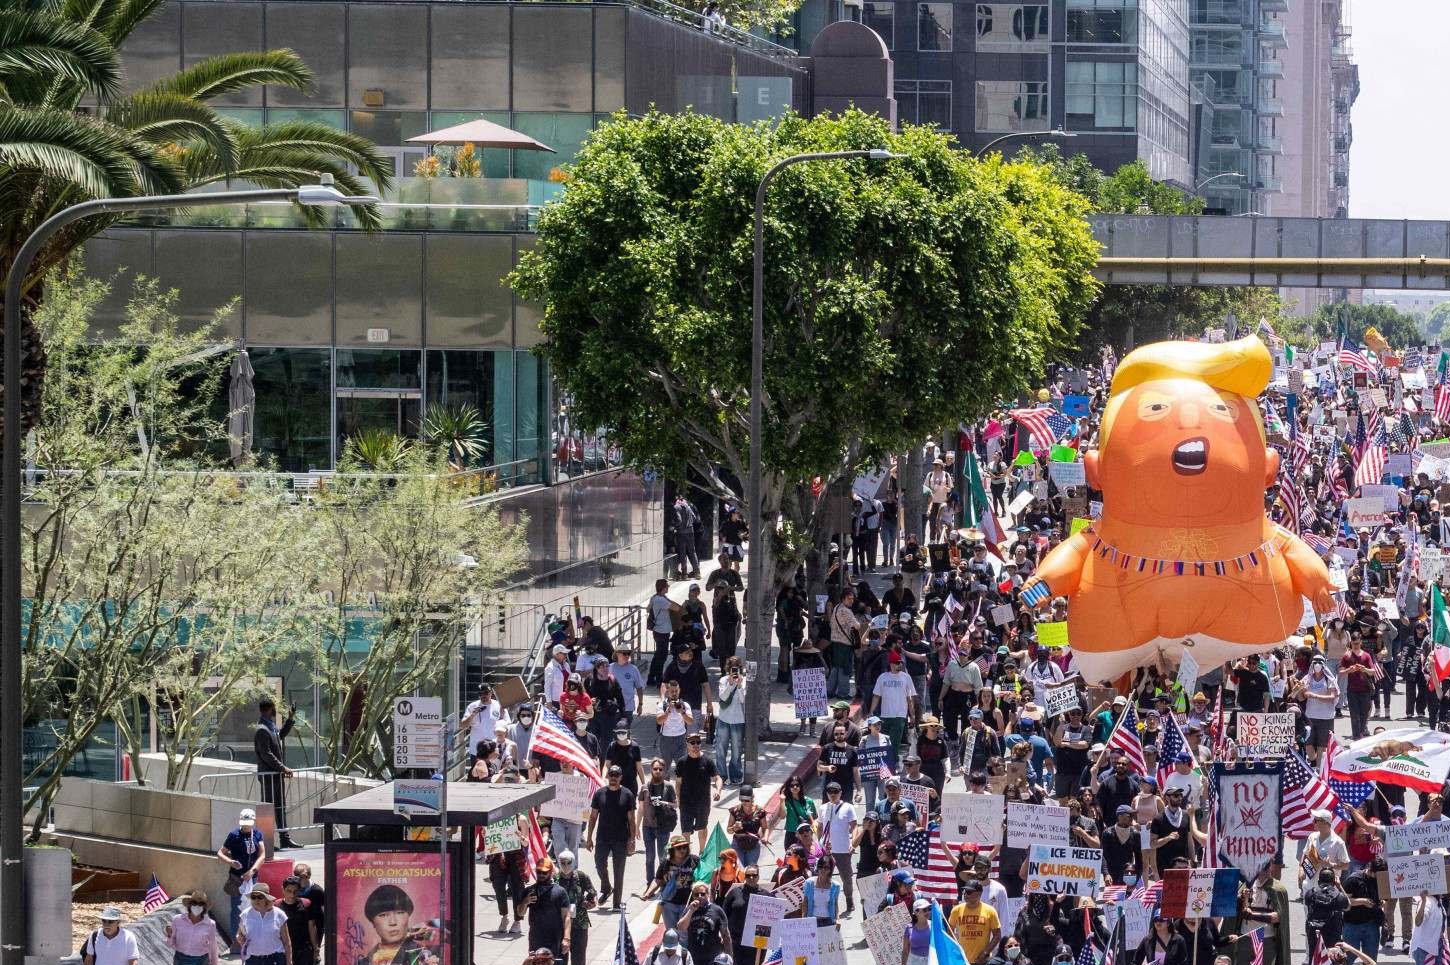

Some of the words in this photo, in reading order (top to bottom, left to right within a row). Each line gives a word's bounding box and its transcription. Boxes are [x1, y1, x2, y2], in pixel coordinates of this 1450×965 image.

[1241, 715, 1257, 727] NO
[1264, 714, 1291, 725] KINGS
[1241, 726, 1258, 736] NO
[1262, 726, 1295, 736] CROWNS
[397, 736, 407, 744] 18
[1241, 736, 1257, 745] NO
[1262, 736, 1292, 744] FASCIST
[397, 746, 408, 754] 20
[397, 757, 408, 765] 53
[500, 840, 521, 850] YOU
[1050, 849, 1066, 859] ICE
[1072, 850, 1102, 861] MELTS
[343, 868, 382, 877] ATSUKO
[387, 868, 441, 877] OKATSUKA
[1029, 863, 1039, 876] IN
[1040, 863, 1096, 881] CALIFORNIA
[1044, 880, 1079, 895] SUN
